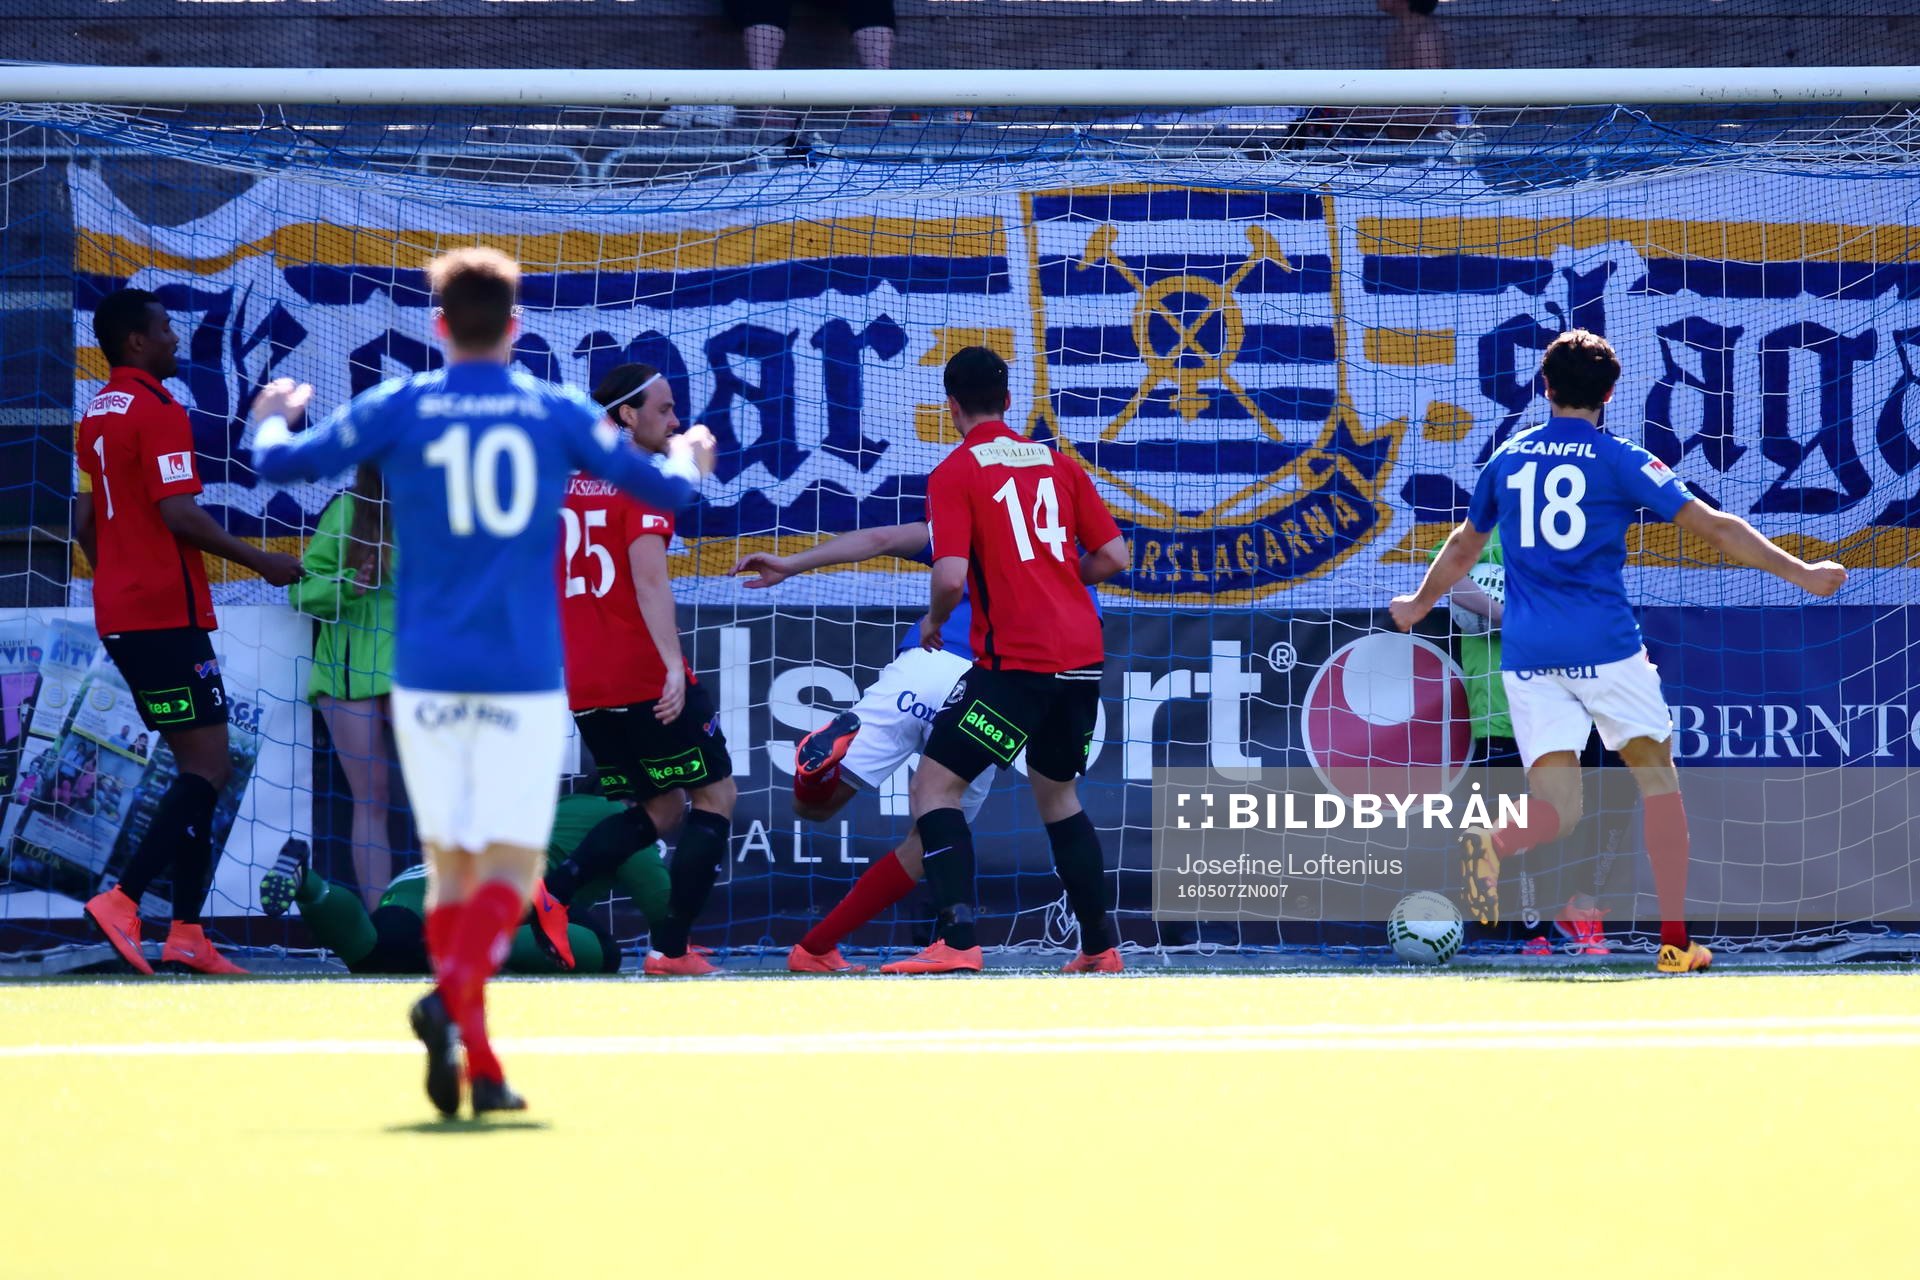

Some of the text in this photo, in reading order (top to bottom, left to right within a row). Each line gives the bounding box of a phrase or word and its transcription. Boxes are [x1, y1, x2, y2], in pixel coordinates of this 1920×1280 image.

[1505, 440, 1597, 459] SCANFIL
[424, 422, 538, 538] 10
[1506, 461, 1587, 551] 18
[992, 476, 1067, 562] 14
[558, 507, 616, 598] 25
[211, 687, 223, 706] 3
[896, 690, 938, 724] Cor
[966, 710, 1004, 743] akea
[1672, 703, 1920, 758] BERNT
